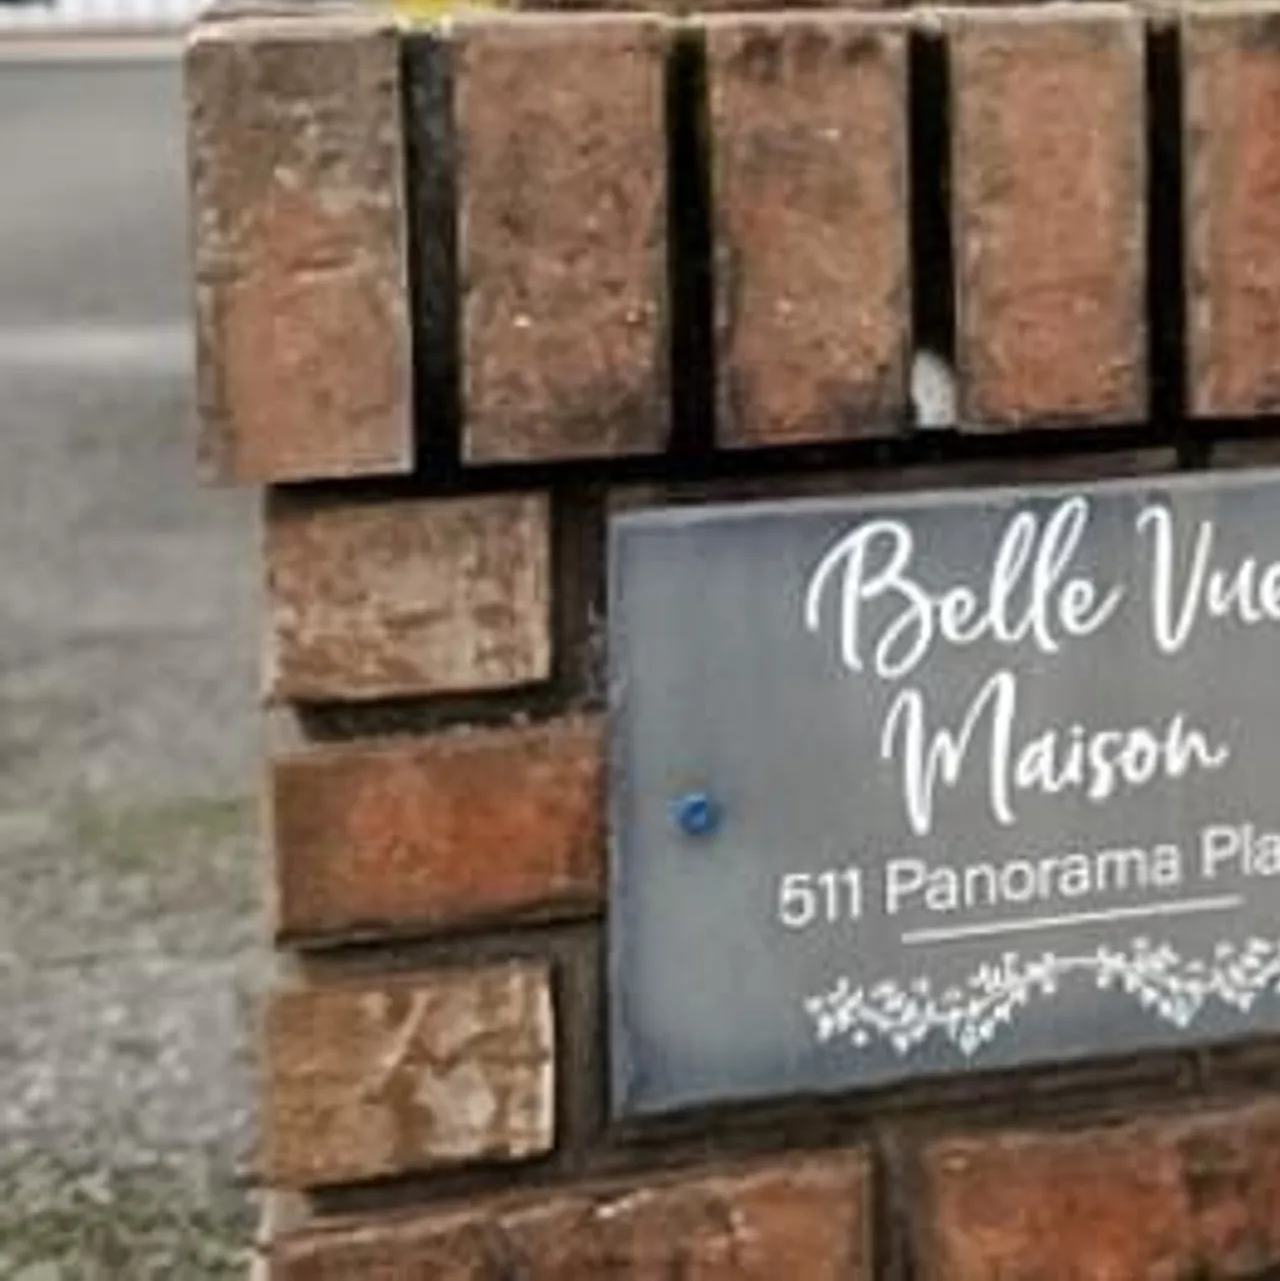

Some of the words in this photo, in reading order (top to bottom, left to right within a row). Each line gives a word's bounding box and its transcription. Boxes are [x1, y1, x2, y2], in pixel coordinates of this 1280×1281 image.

[805, 495, 1125, 678] Belle
[881, 671, 1229, 836] Maison
[779, 868, 863, 926] 511
[885, 839, 1182, 916] Panorama
